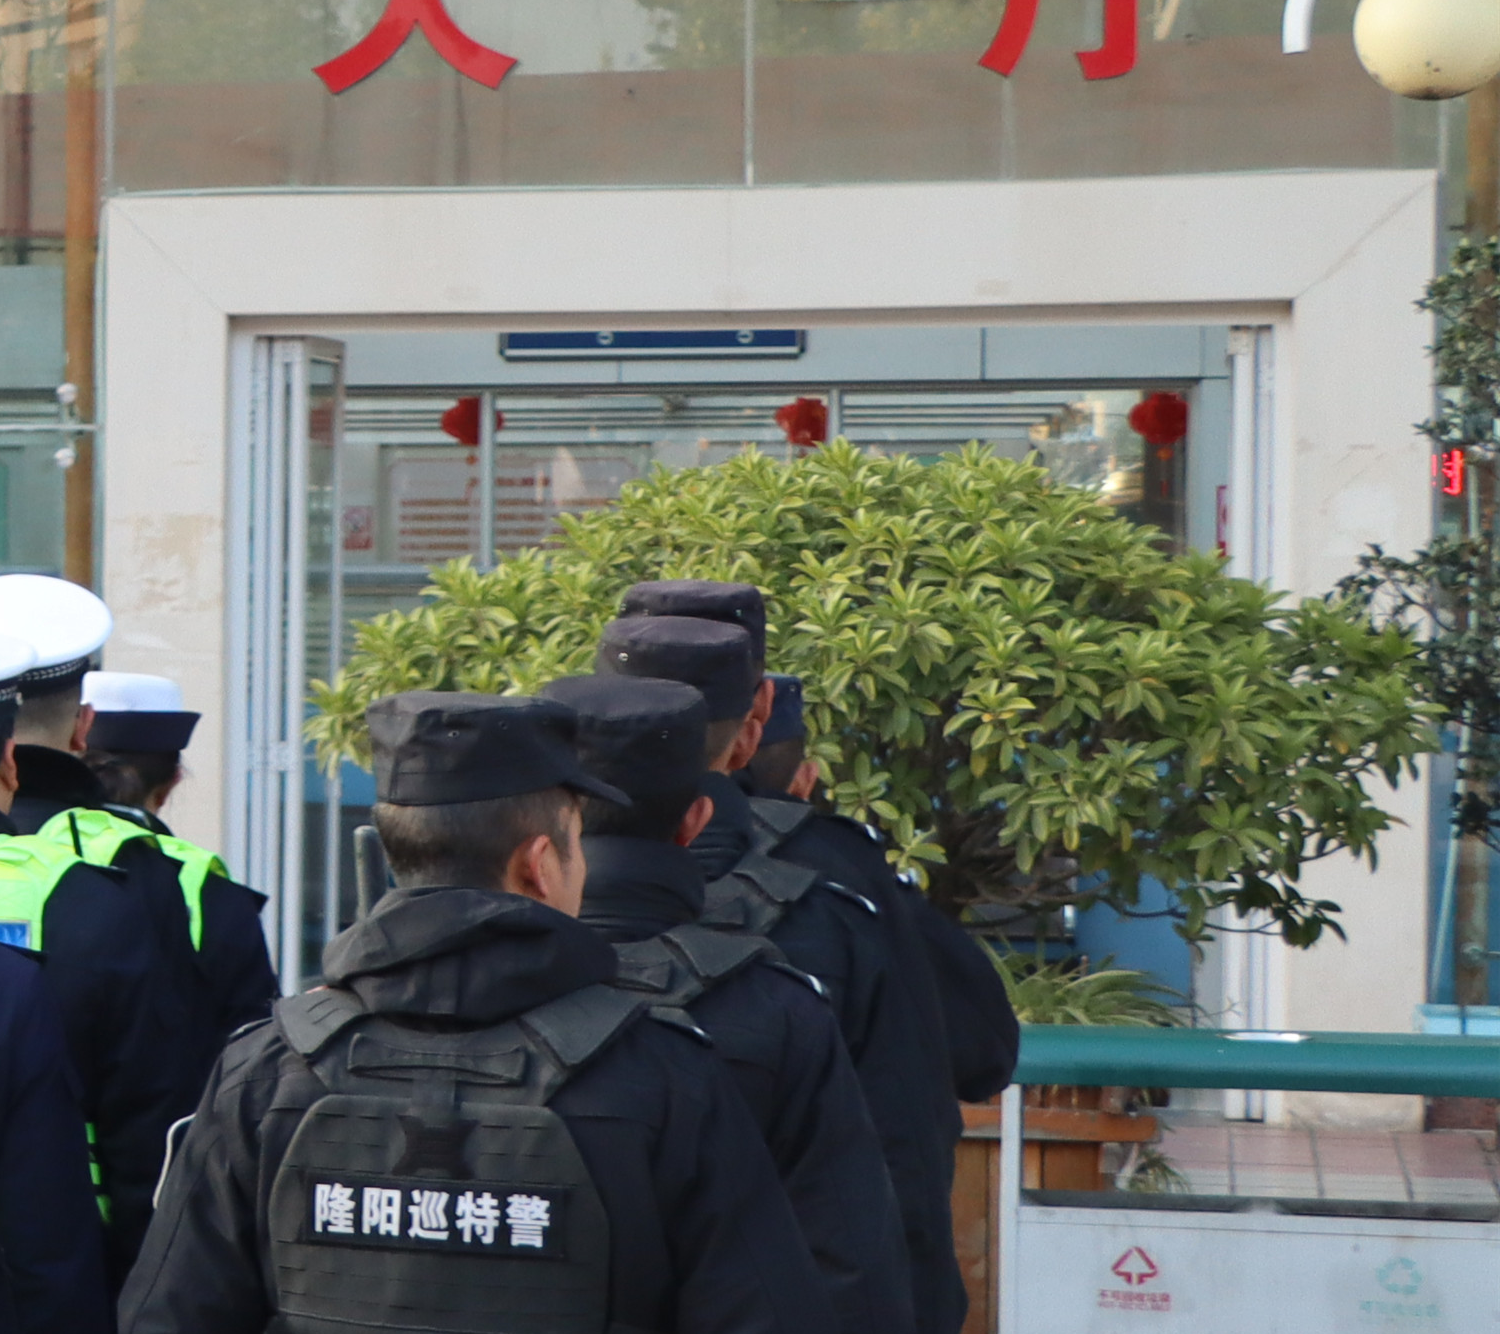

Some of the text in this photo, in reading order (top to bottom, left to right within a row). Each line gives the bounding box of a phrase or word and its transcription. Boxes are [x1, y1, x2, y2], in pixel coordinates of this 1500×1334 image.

[313, 1182, 551, 1248] 隆阳巡特警
